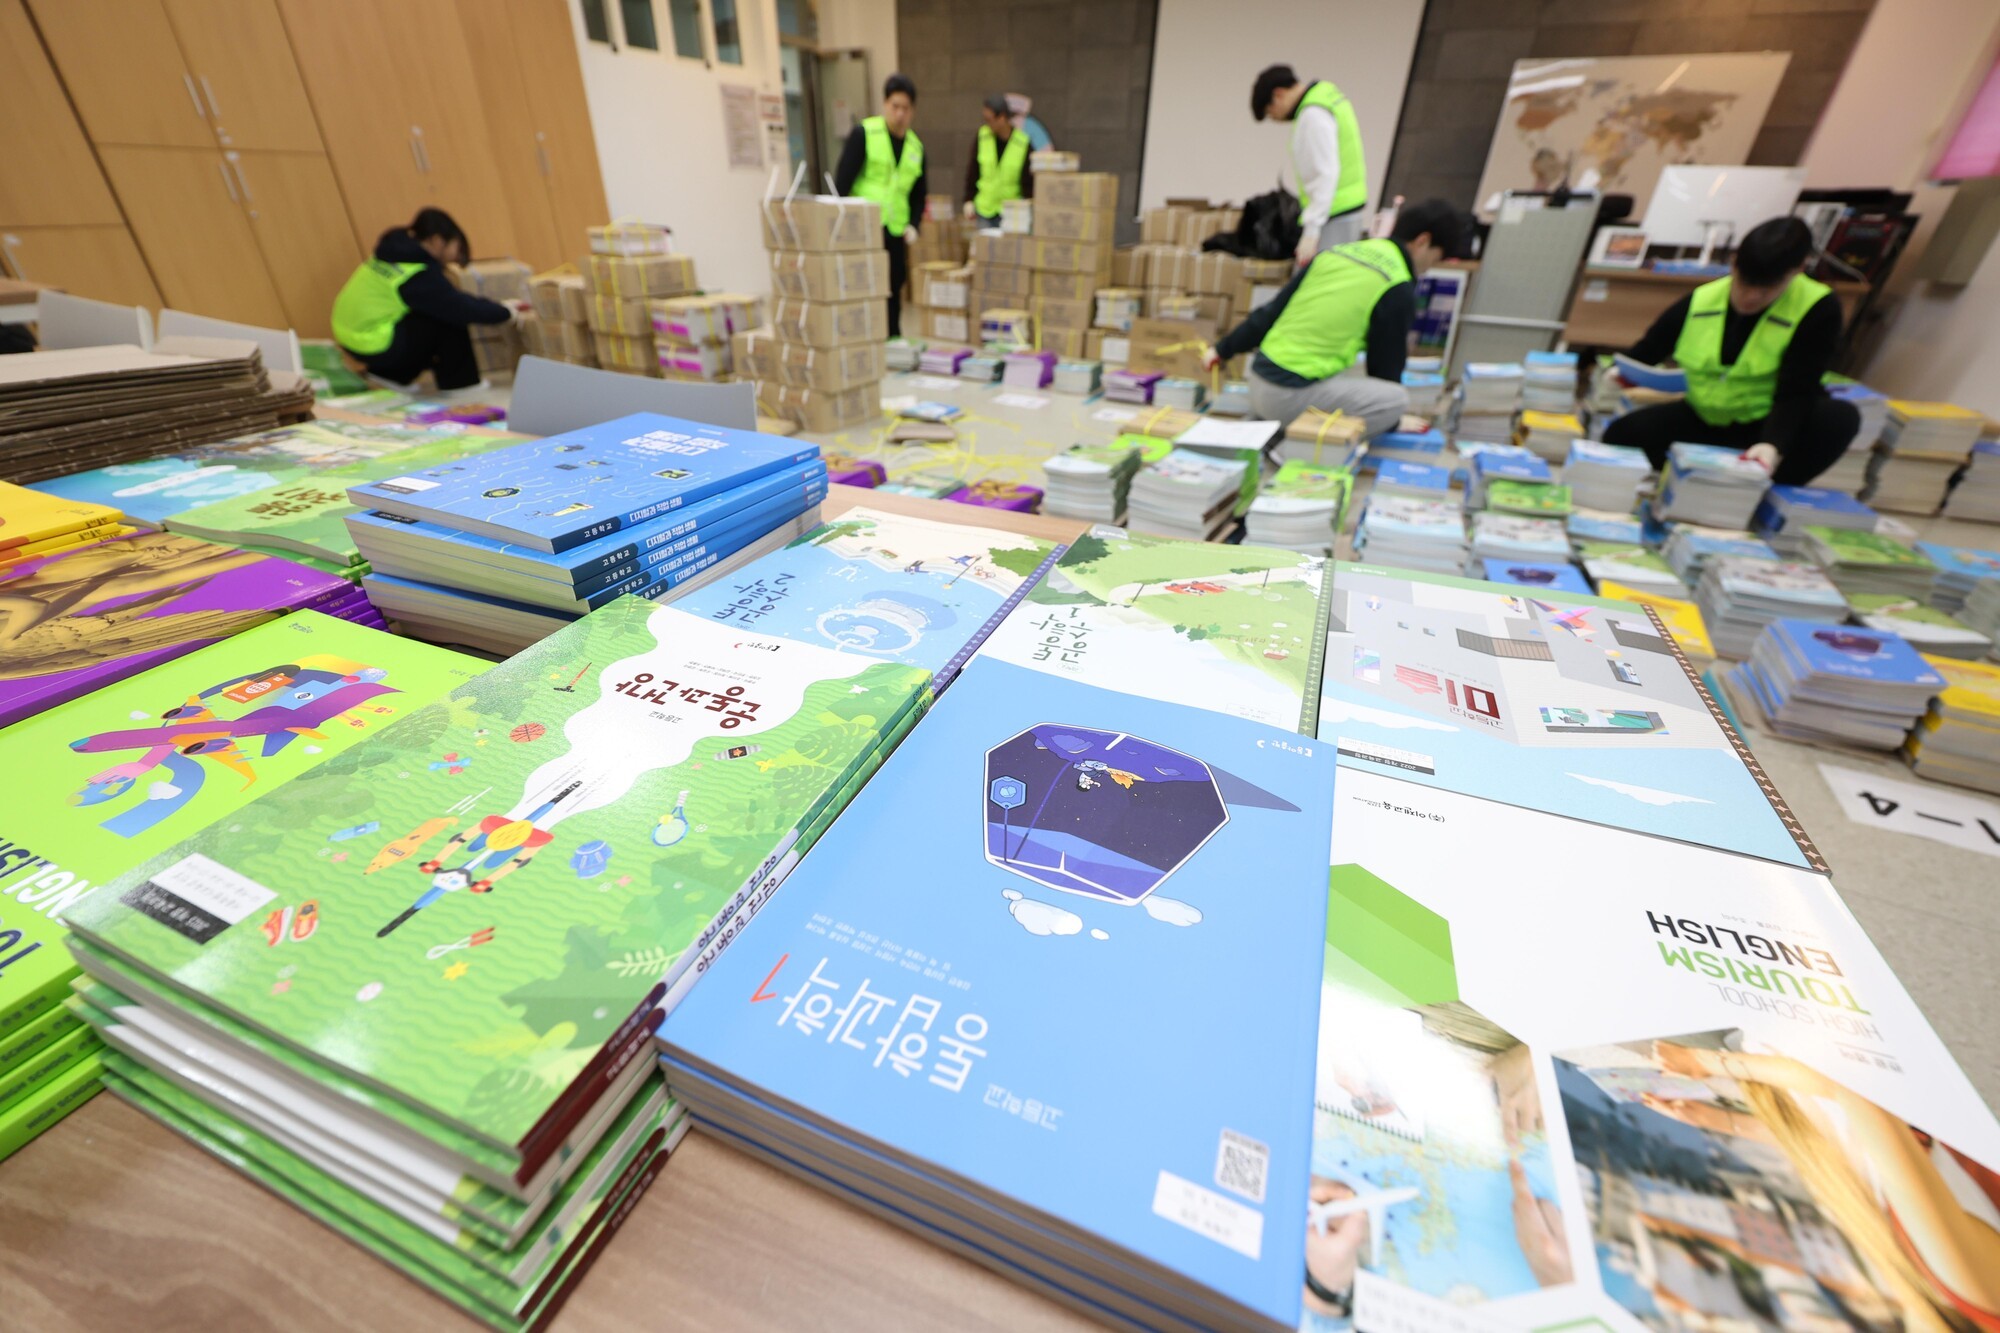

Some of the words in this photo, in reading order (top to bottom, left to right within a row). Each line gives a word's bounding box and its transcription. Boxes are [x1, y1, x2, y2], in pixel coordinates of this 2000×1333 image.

[630, 505, 656, 522] 디지털과
[584, 523, 613, 538] 고등학교
[602, 549, 630, 567] 고등학교
[615, 673, 680, 706] 건강
[649, 711, 685, 724] 고등학교
[680, 686, 762, 729] 운동과
[1449, 706, 1505, 731] 고등학교
[1400, 763, 1417, 771] 2022
[1382, 801, 1427, 819] 이젠교육
[1428, 812, 1446, 823] (주)
[1646, 910, 1844, 977] ENGLISH
[750, 953, 790, 1003] 1
[1656, 940, 1872, 1016] TOURISM
[1708, 982, 1816, 1025] SCHOOL
[777, 957, 989, 1094] 통합과학
[1820, 1010, 1884, 1042] HIGH
[983, 1082, 1064, 1132] 고등학교
